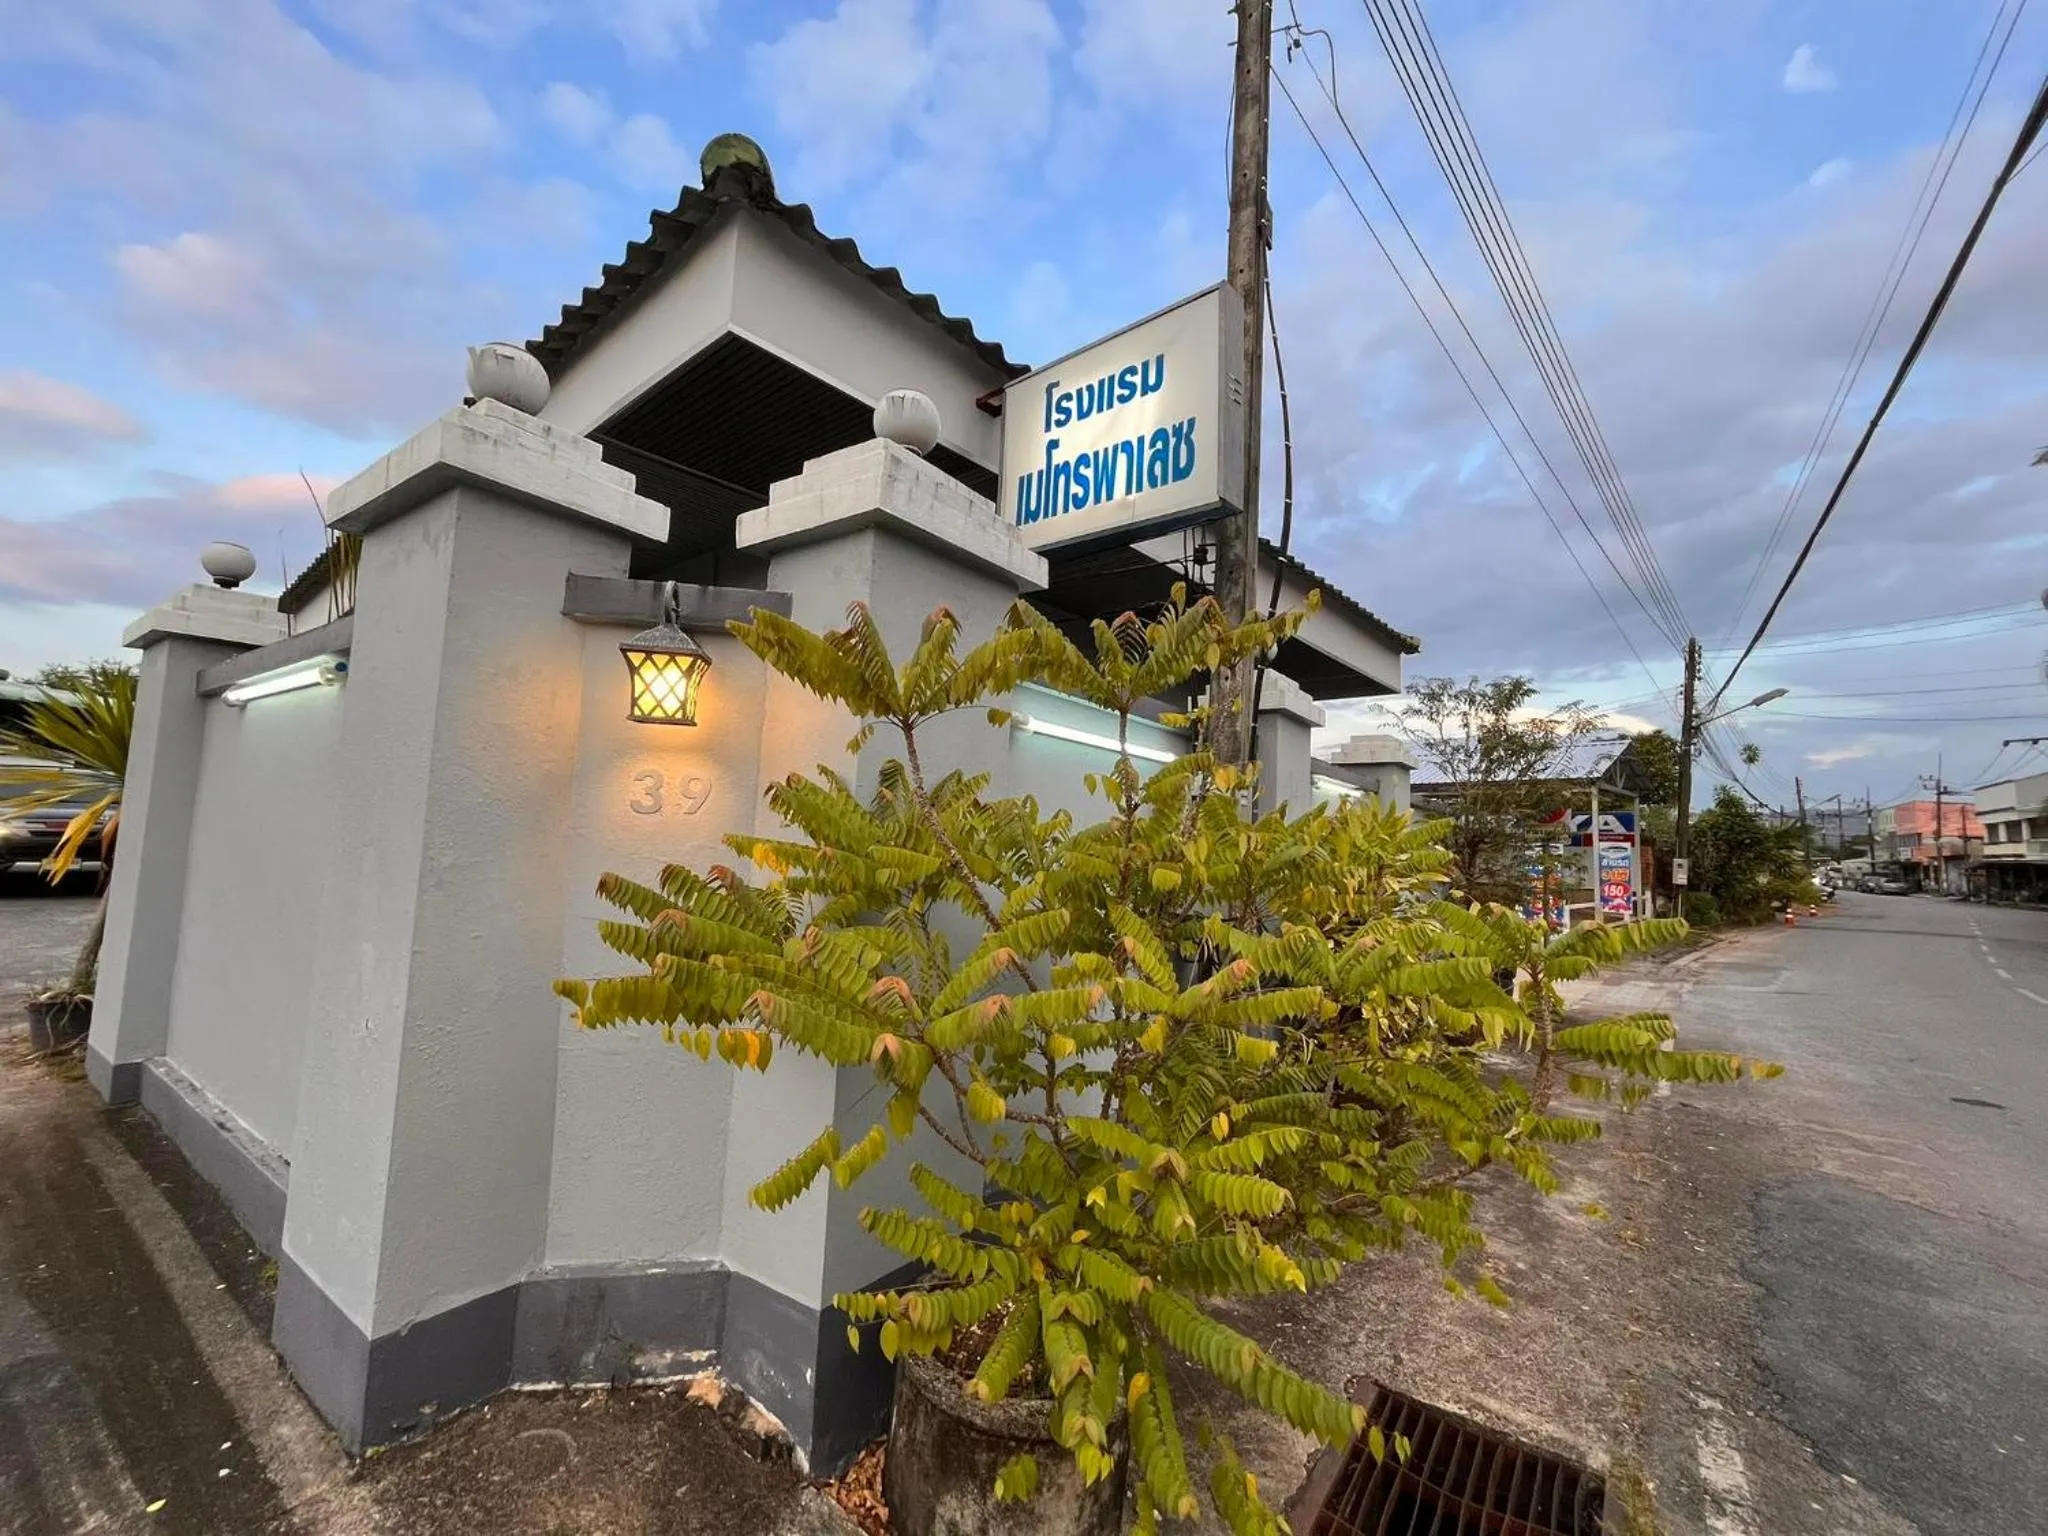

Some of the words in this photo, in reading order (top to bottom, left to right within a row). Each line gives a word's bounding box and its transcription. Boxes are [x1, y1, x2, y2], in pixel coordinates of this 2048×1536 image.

[1044, 353, 1165, 433] โรงแรม
[630, 769, 713, 815] 39
[1603, 884, 1625, 897] 150
